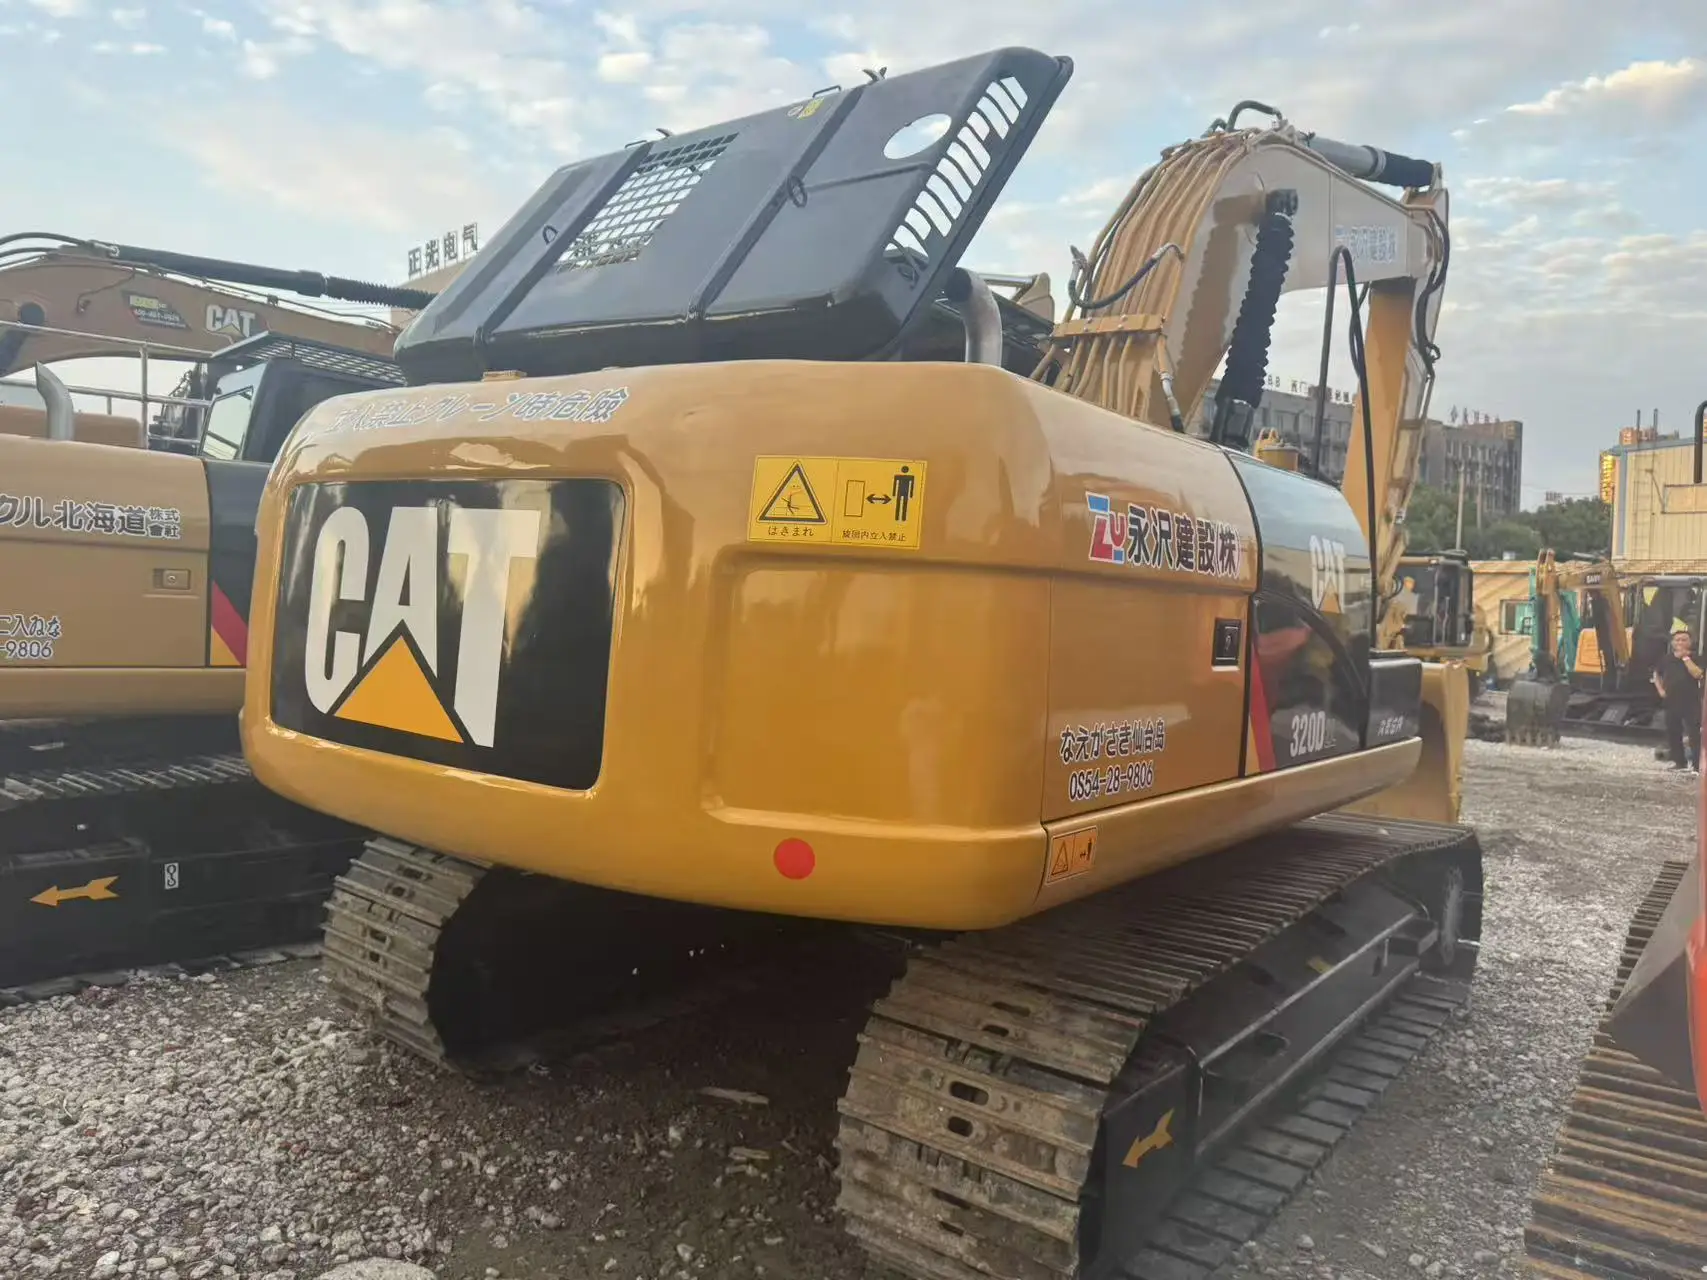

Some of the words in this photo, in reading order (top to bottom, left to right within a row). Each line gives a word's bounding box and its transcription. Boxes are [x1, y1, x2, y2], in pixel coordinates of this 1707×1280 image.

[408, 222, 479, 276] 正光电气
[206, 304, 256, 338] CAT
[1309, 534, 1346, 614] CAT
[304, 506, 541, 748] CAT
